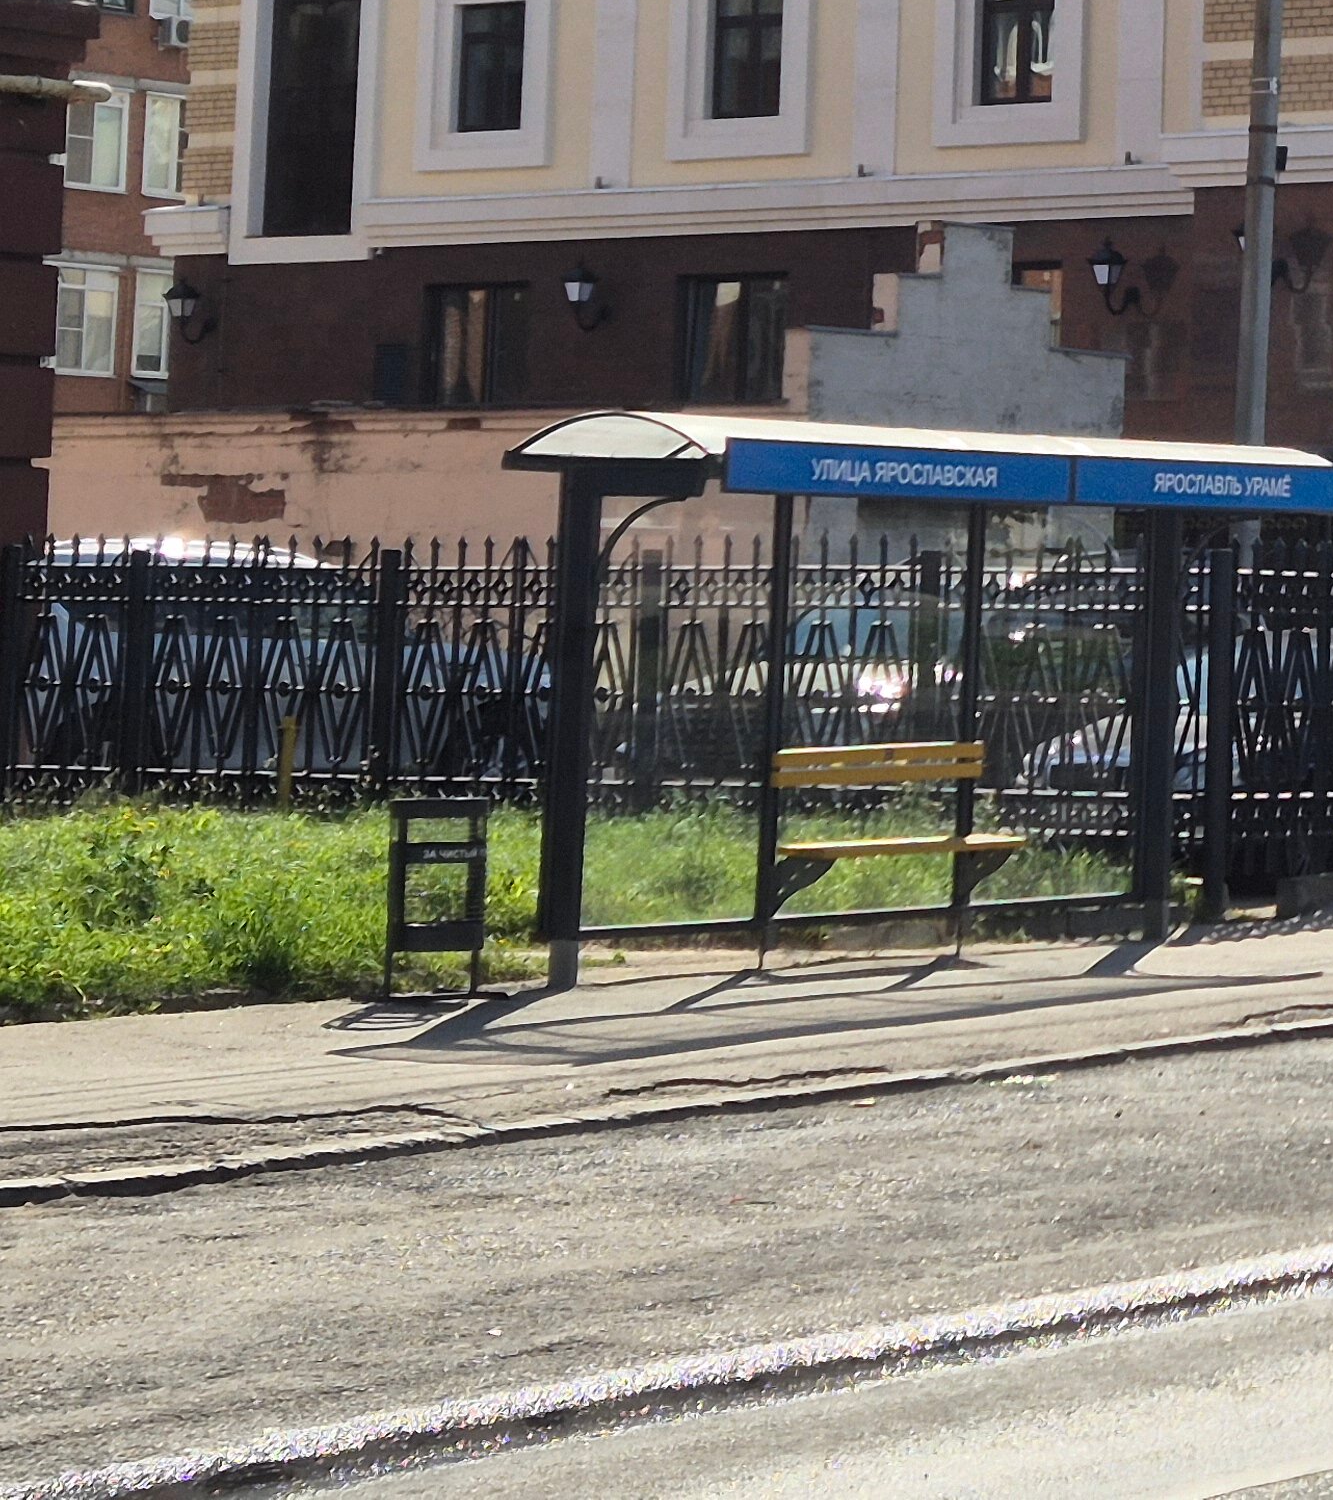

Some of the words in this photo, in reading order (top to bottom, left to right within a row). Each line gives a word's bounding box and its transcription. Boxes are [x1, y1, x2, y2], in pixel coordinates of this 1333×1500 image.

[811, 457, 871, 486] УЛИЦА
[873, 460, 998, 487] ЯРОСЛАВСКАЯ
[1153, 472, 1243, 496] ЯРОСЛАВЛЬ
